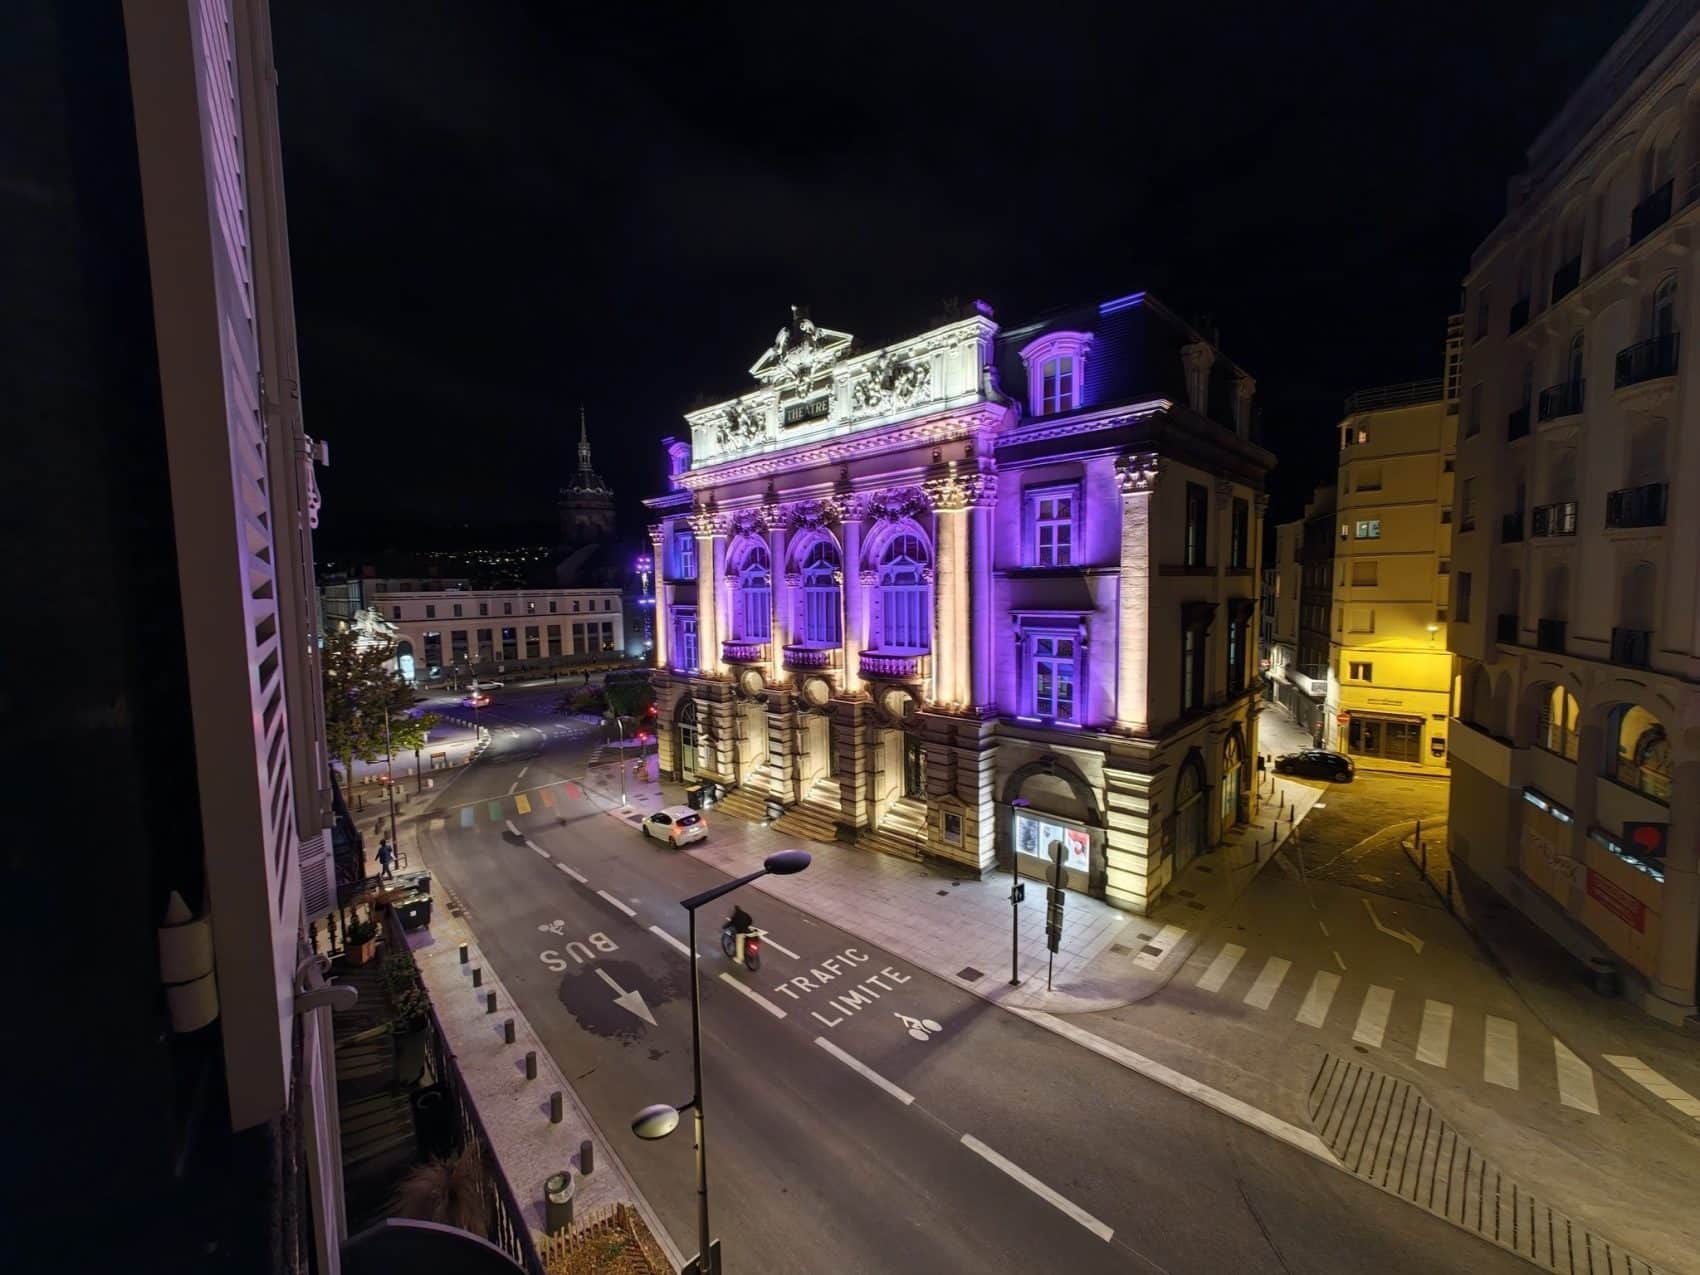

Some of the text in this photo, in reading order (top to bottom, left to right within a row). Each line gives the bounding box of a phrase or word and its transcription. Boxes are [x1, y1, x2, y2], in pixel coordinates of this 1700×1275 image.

[539, 932, 619, 973] BUS
[774, 947, 869, 1000] TRAFIC
[811, 967, 912, 1028] LIMITE
